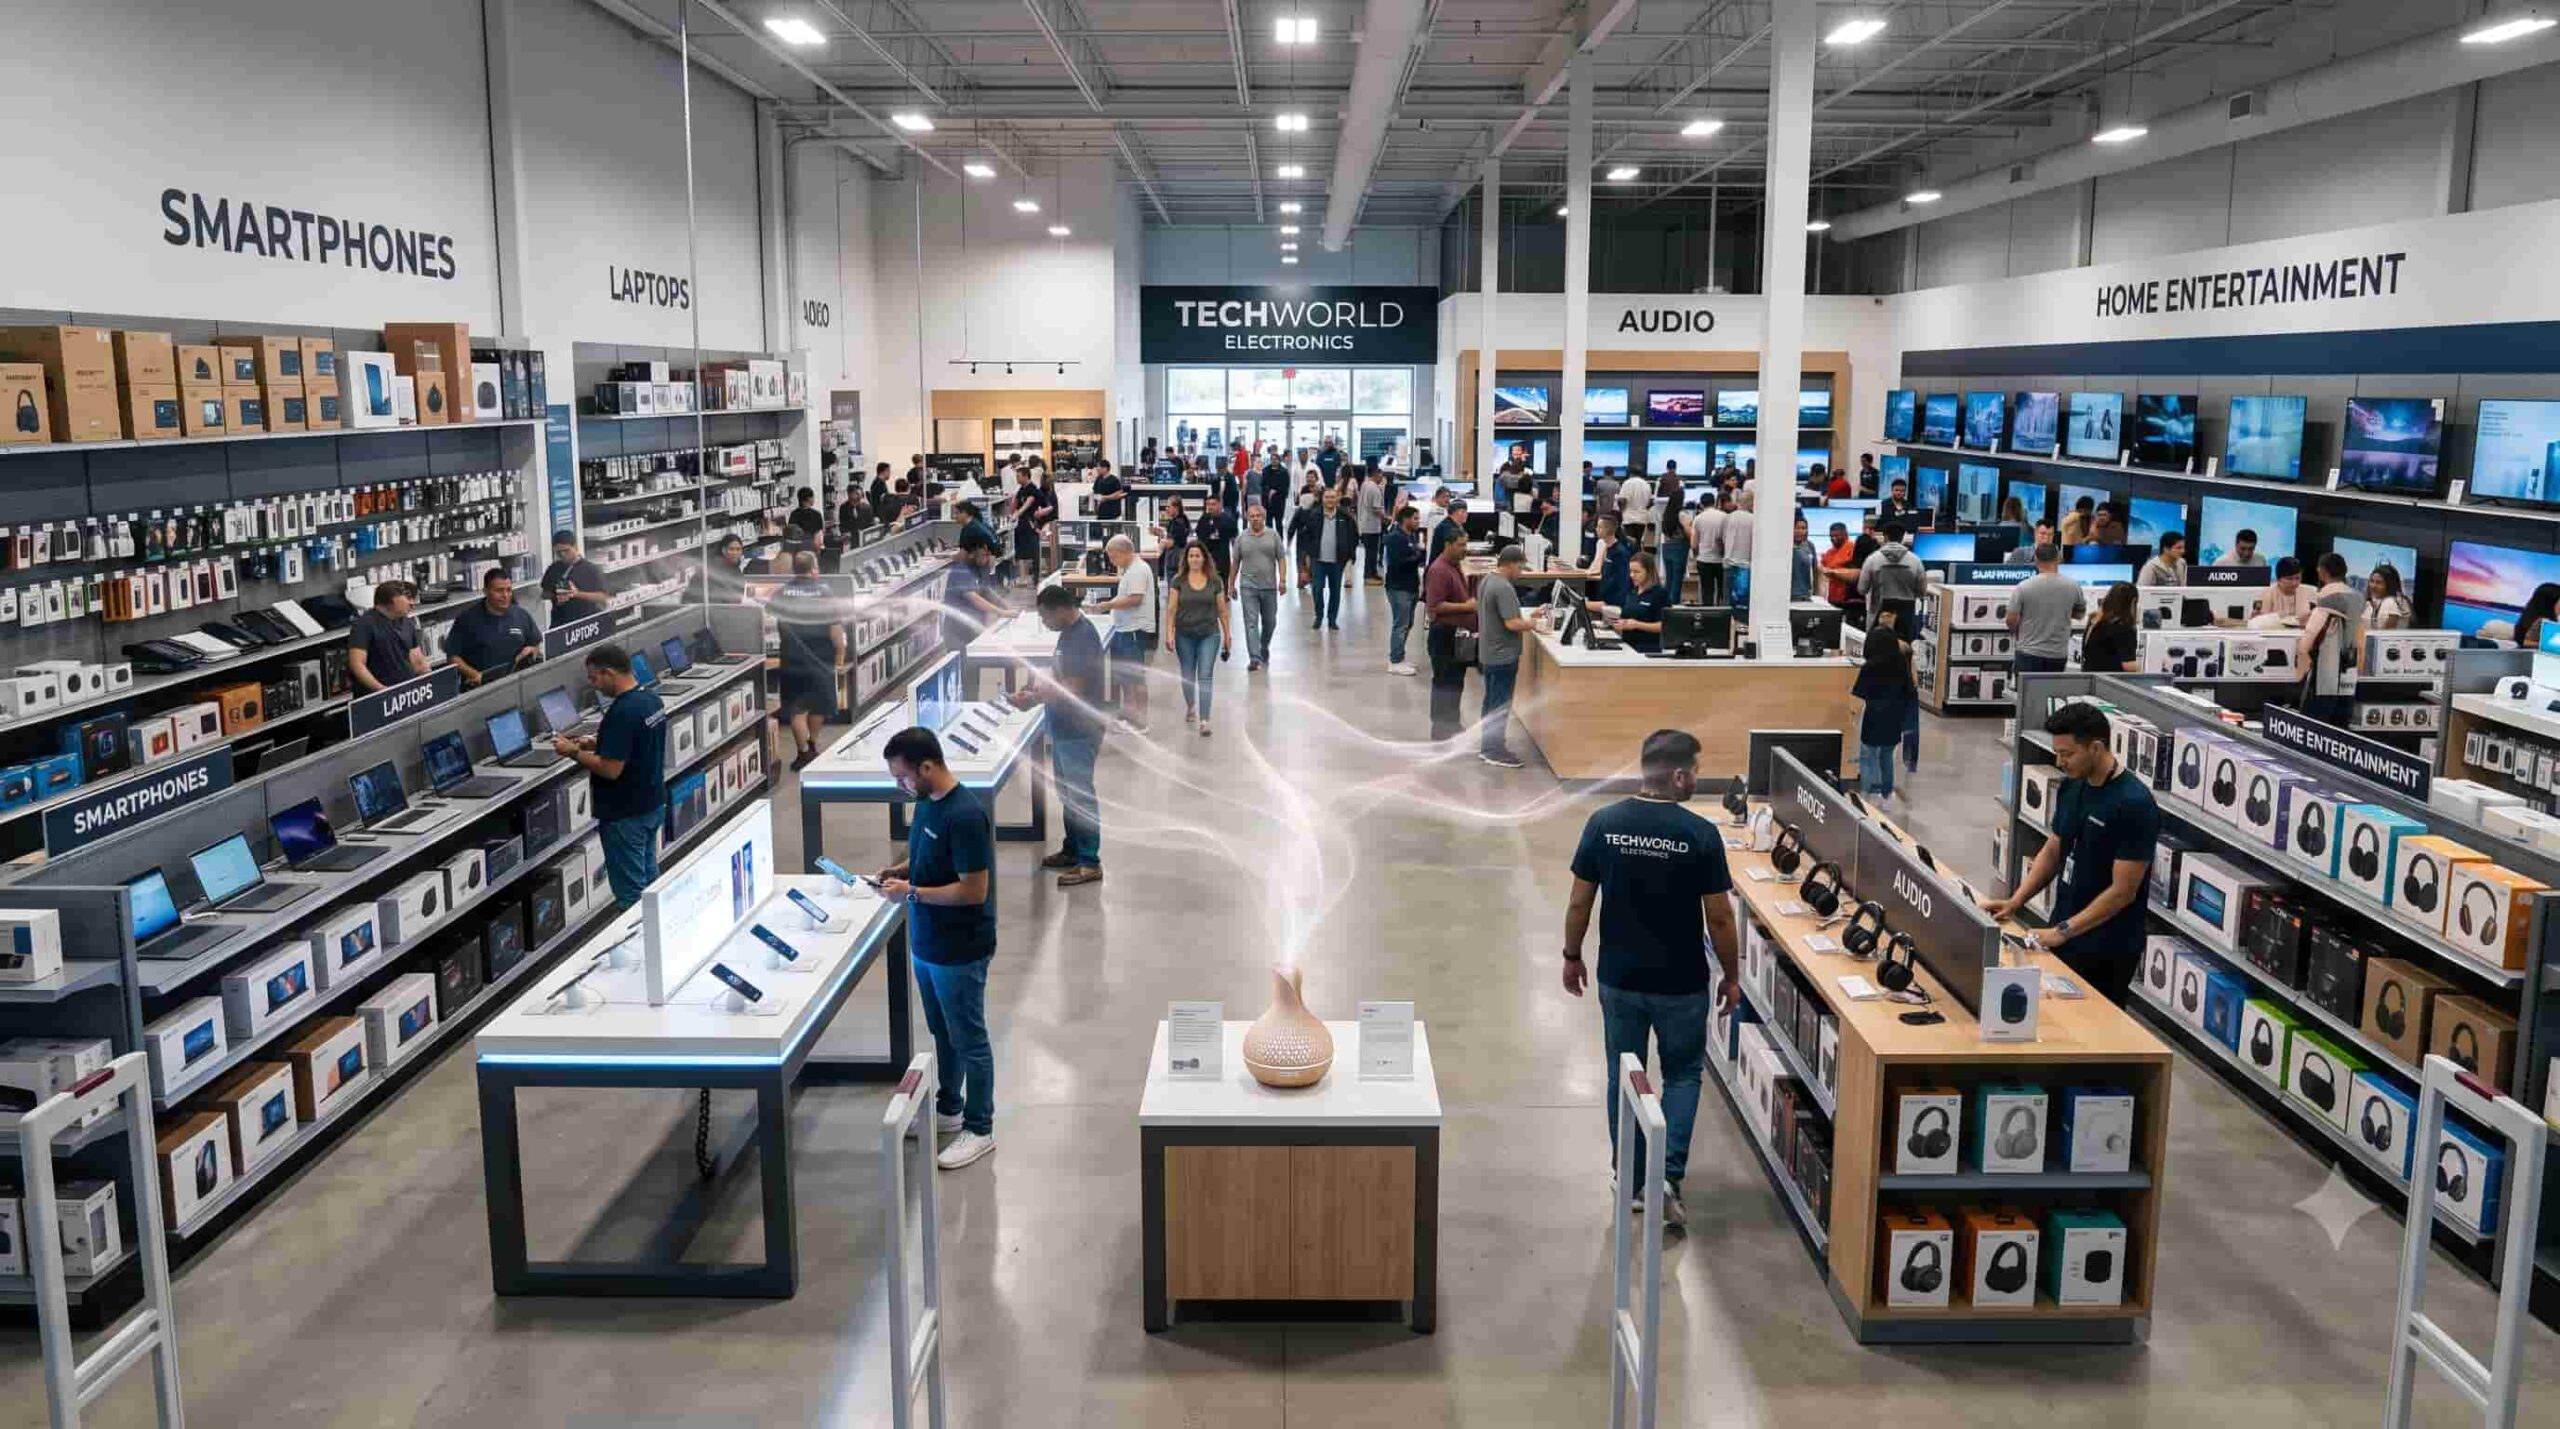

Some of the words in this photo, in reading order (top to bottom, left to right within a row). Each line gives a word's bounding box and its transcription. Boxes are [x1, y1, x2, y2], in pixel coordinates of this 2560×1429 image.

[160, 187, 457, 281] SMARTPHONES
[609, 264, 691, 310] LAPTOPS
[2095, 281, 2160, 318] HOME
[2164, 251, 2407, 313] ENTERTAINMENT
[1174, 300, 1404, 328] TECHWORLD
[1617, 309, 1715, 333] AUDIO
[1224, 334, 1355, 351] ELECTRONICS
[2207, 571, 2238, 582] AUDIO
[565, 621, 600, 646] LAPTOPS
[382, 683, 434, 718] LAPTOPS
[2268, 716, 2304, 745] HOME
[2306, 730, 2420, 789] ENTERTAINMENT
[73, 766, 209, 835] SMARTPHONES
[1603, 833, 1690, 854] TECHWORLD
[1892, 868, 1932, 919] AUDIO
